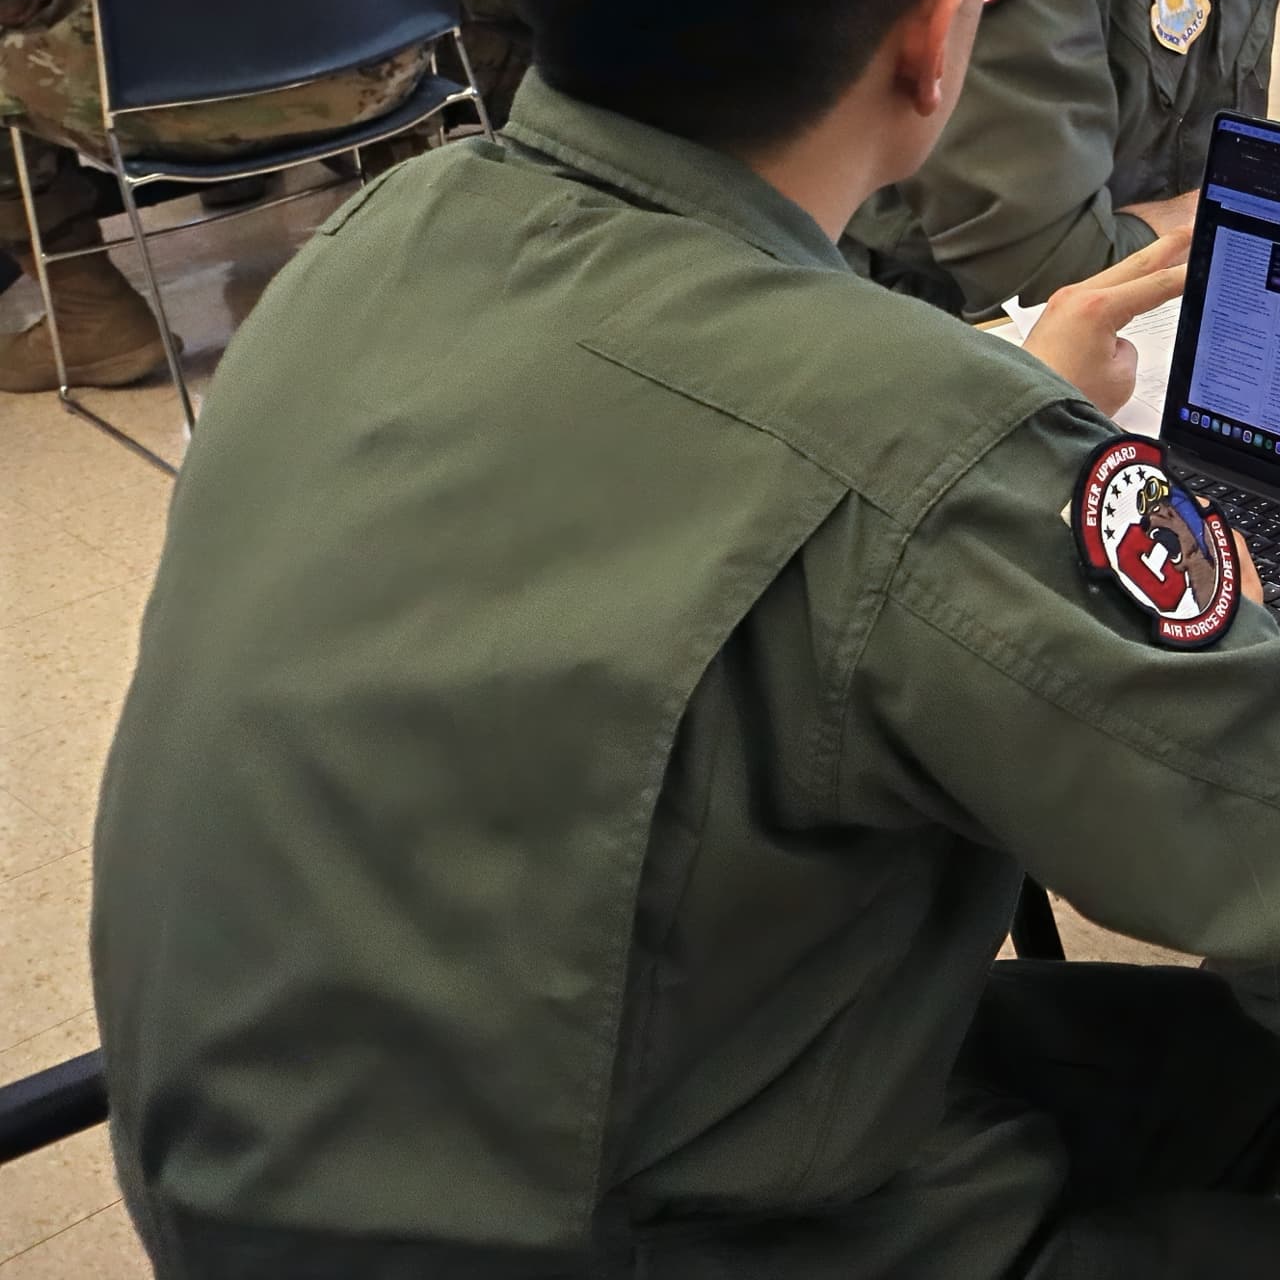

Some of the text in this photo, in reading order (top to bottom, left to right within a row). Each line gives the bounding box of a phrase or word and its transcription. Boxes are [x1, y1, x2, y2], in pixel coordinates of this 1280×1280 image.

[1086, 445, 1137, 527] EVER UPWARD
[1222, 550, 1234, 579] DET
[1216, 582, 1234, 618] ROTC
[1163, 622, 1184, 638] AIR
[1185, 613, 1220, 639] FORCE
